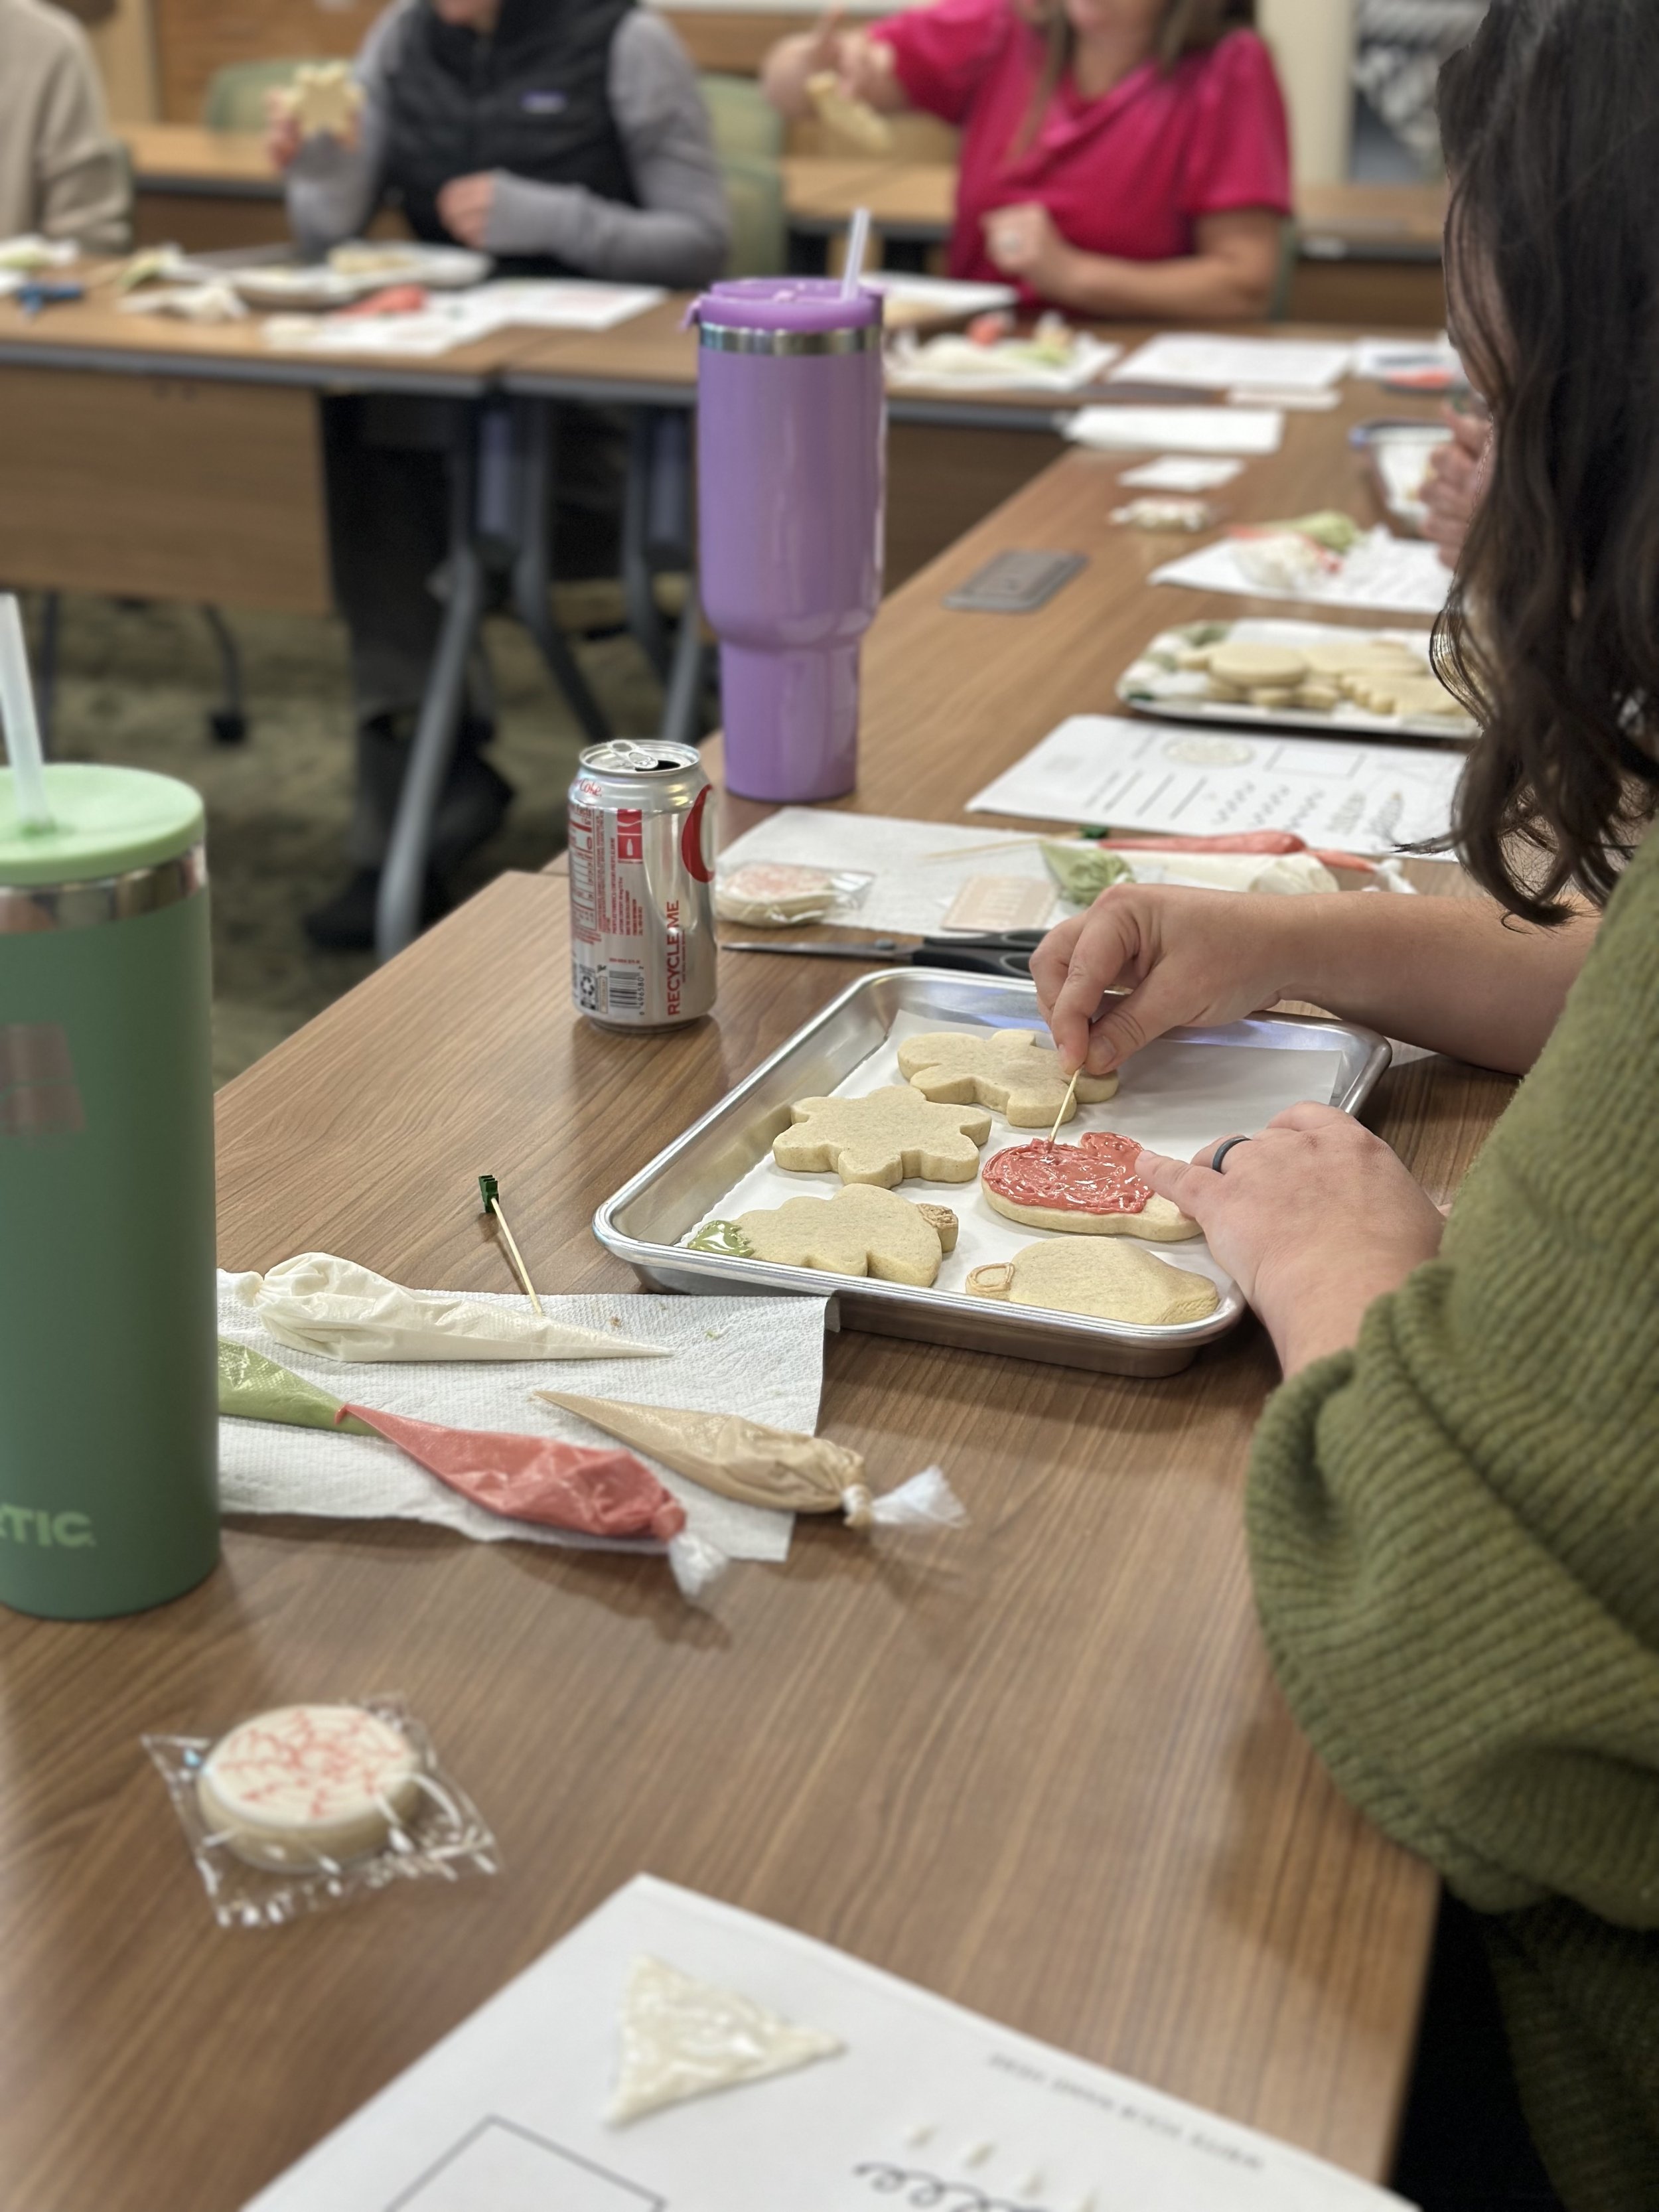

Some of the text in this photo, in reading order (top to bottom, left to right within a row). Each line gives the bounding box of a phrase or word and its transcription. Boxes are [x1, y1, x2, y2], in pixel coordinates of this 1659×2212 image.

[666, 899, 680, 1016] RECYCLE ME
[0, 1503, 92, 1548] TIC
